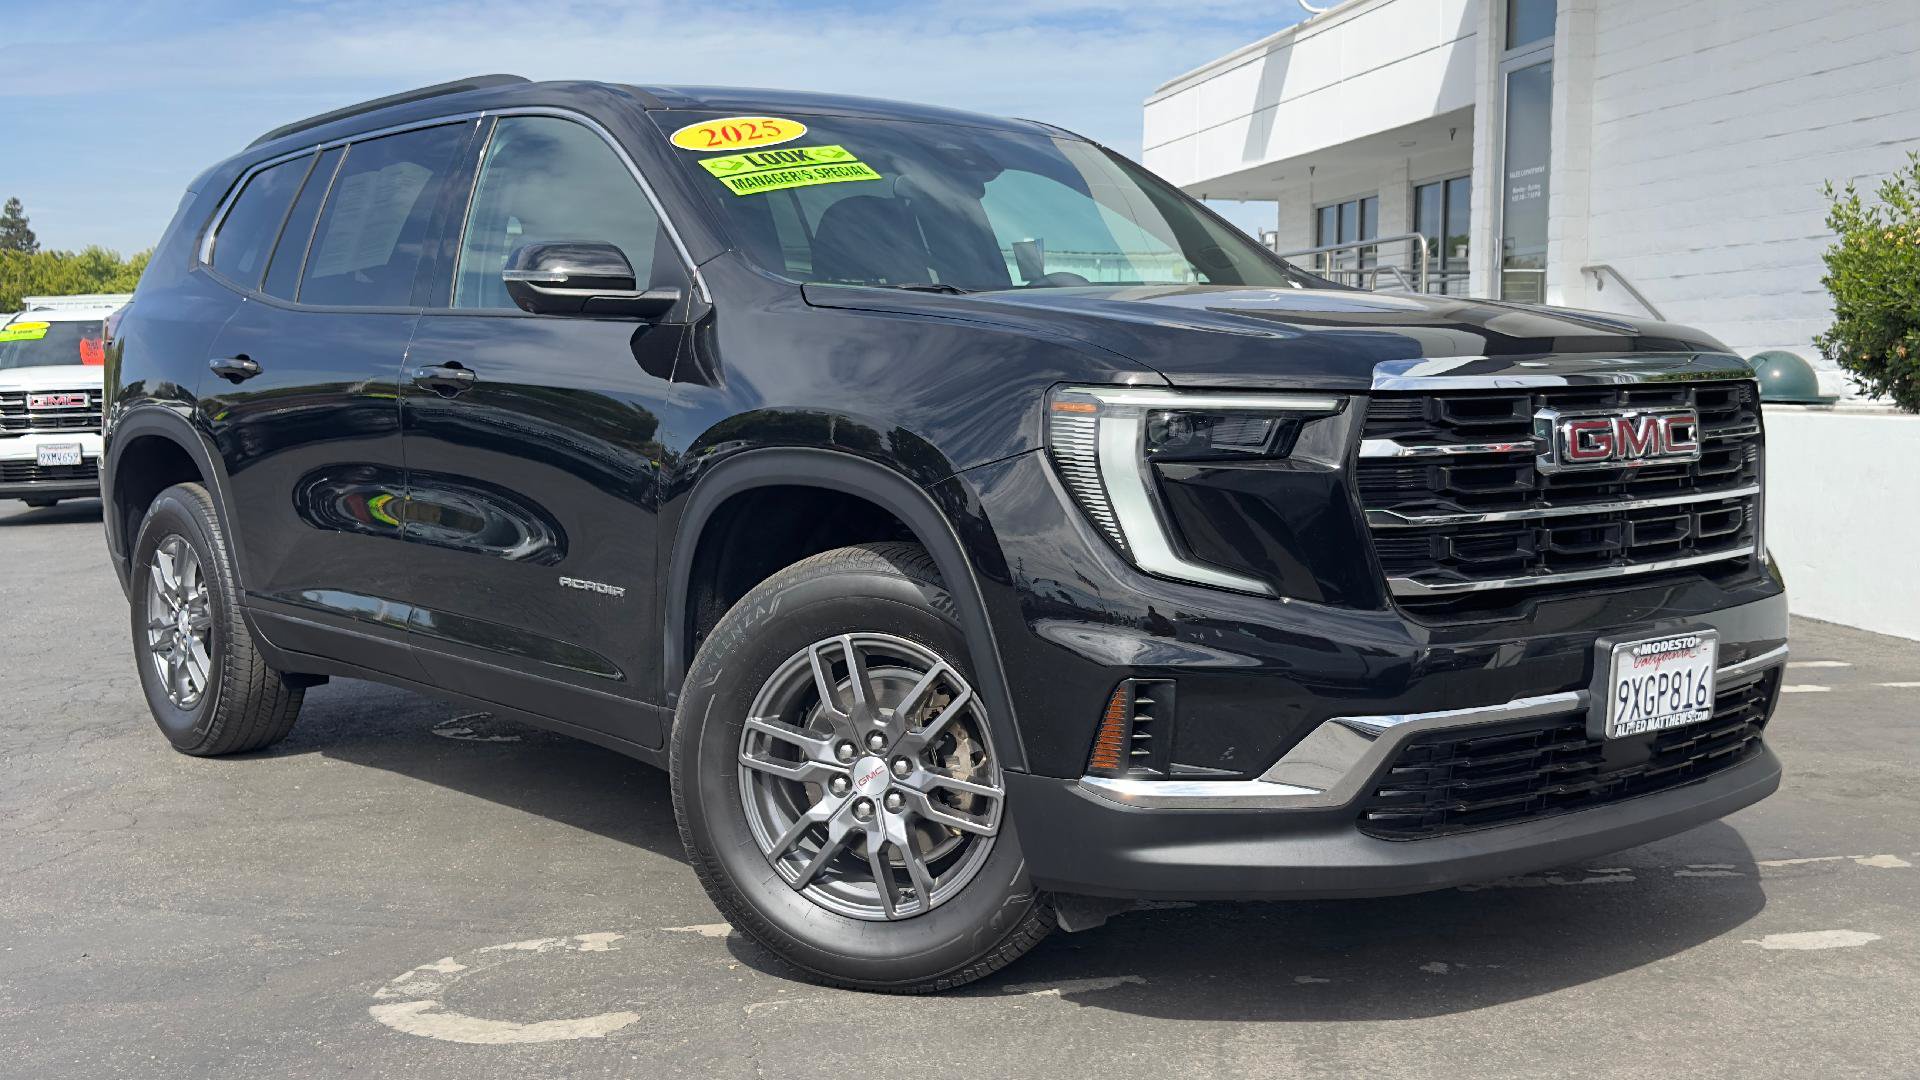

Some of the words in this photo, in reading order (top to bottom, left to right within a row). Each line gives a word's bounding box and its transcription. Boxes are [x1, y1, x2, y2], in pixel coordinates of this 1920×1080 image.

[699, 120, 781, 147] 2025
[743, 149, 816, 168] LOOK
[730, 170, 813, 191] MANAGER'S
[816, 164, 871, 179] SPECIAL
[31, 395, 85, 406] GMC
[1564, 415, 1698, 462] GMC
[559, 576, 626, 597] ACADIA
[1640, 636, 1696, 655] MODESTO
[1616, 665, 1709, 722] 9XGP816
[858, 765, 886, 787] GMC
